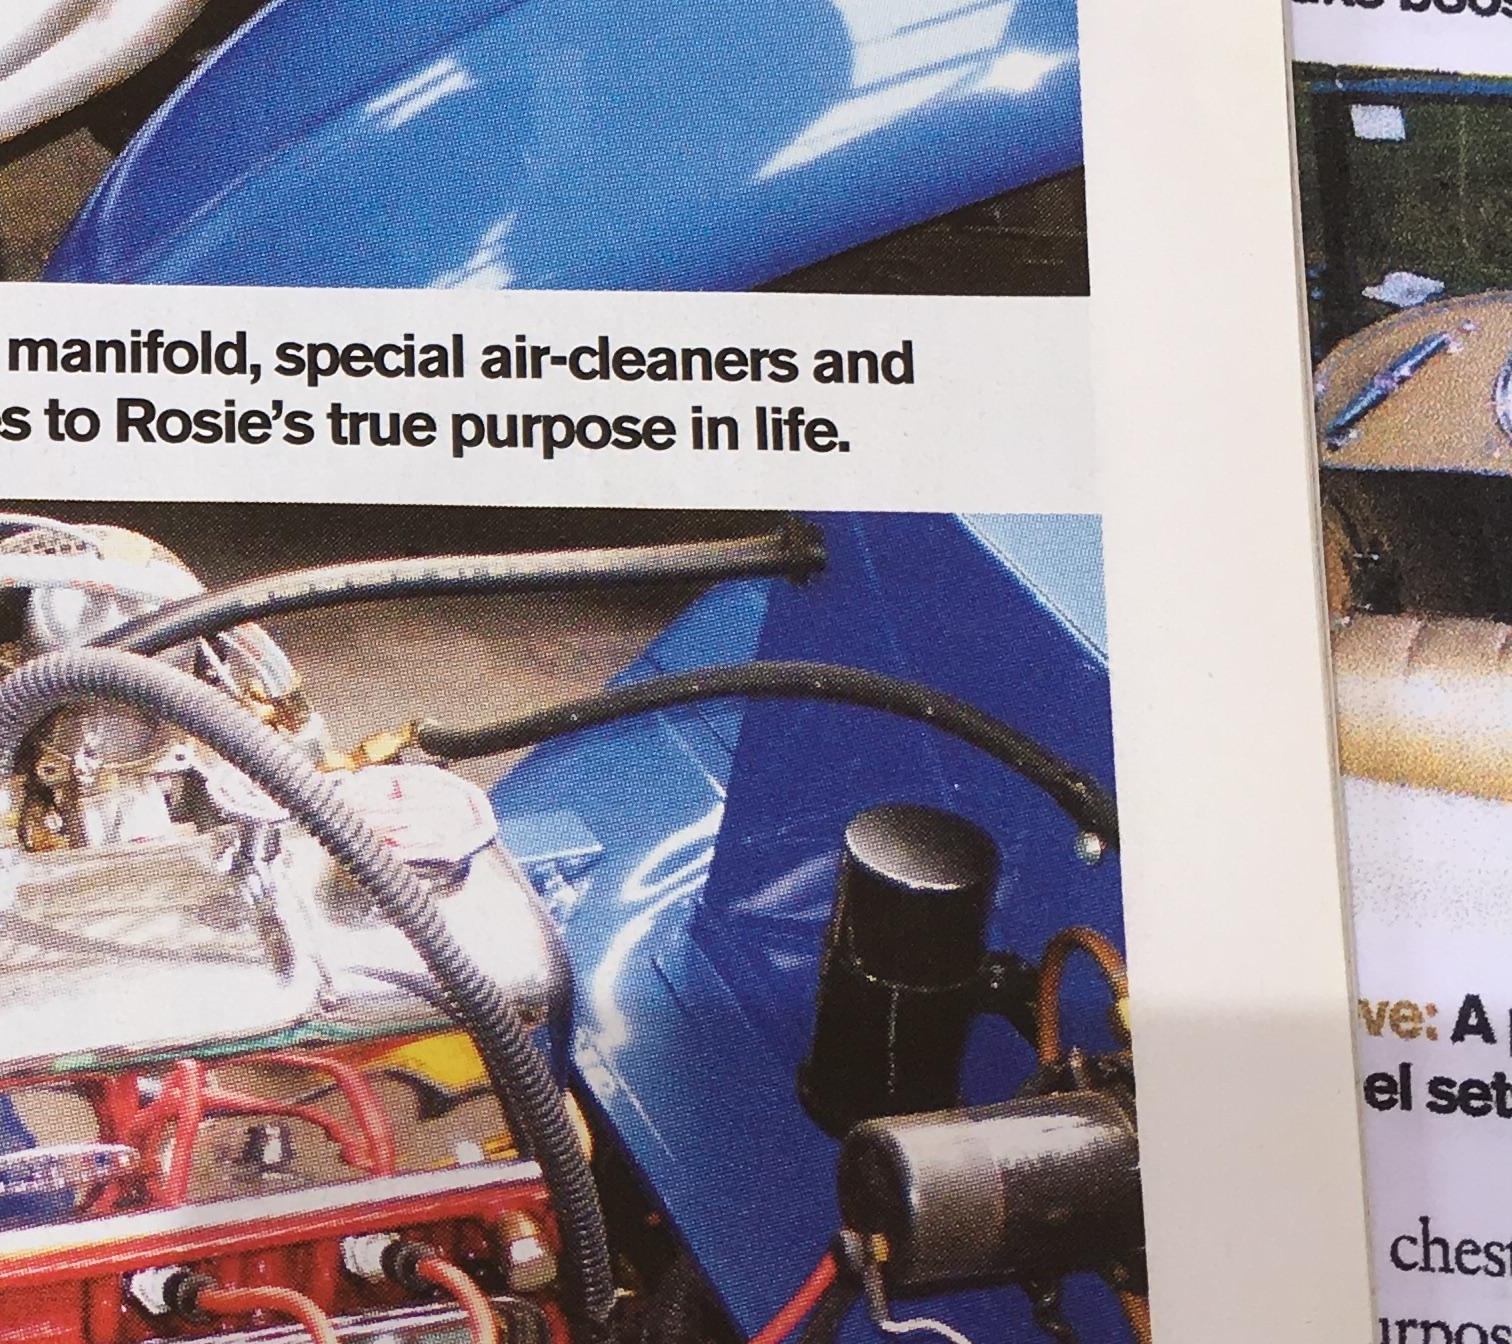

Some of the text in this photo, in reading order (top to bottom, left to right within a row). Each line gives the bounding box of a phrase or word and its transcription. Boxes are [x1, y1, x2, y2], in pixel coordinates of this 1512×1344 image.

[7, 329, 261, 385] manifold,
[273, 333, 464, 387] special
[479, 334, 799, 383] air-cleaners
[812, 340, 915, 385] and
[43, 398, 100, 443] to
[325, 403, 438, 447] true
[451, 413, 677, 460] purpose
[690, 406, 739, 451] in
[755, 406, 851, 453] life.
[1450, 993, 1497, 1044] A
[1363, 1062, 1413, 1112] el
[1389, 1216, 1512, 1277] ches
